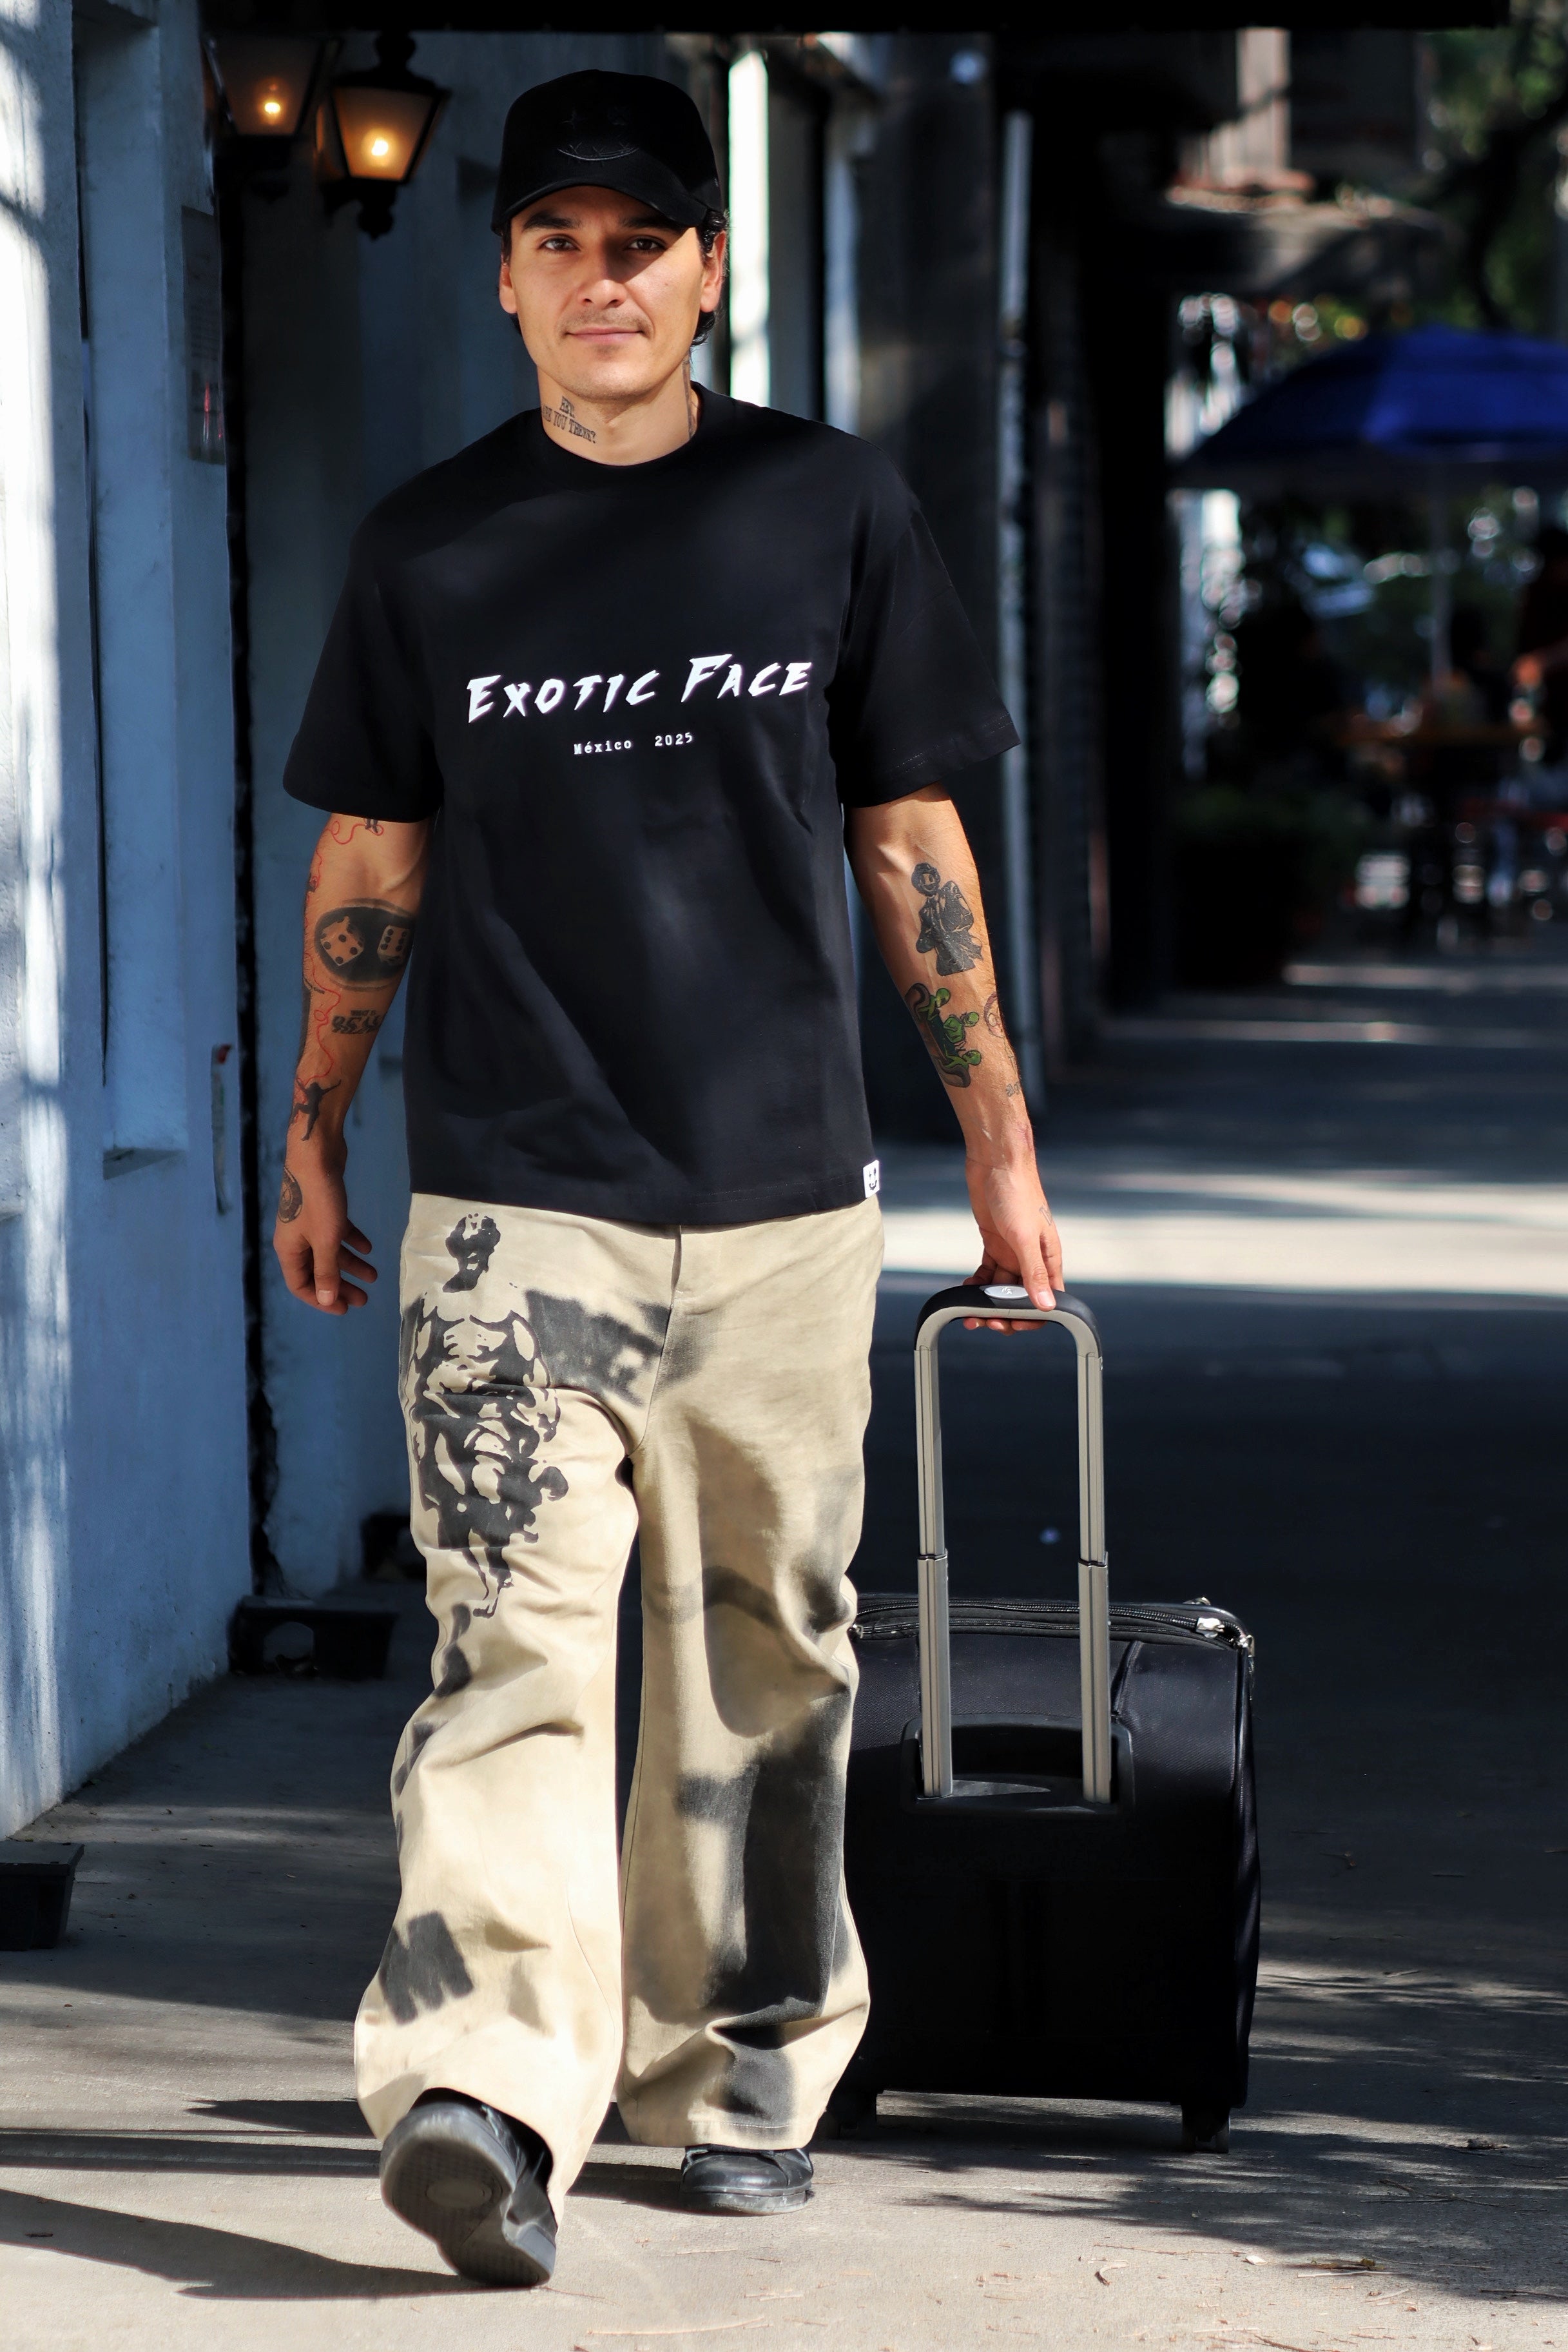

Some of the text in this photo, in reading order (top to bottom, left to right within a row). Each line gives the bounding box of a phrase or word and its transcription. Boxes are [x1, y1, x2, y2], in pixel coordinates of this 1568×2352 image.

[553, 410, 568, 431] YOU
[568, 418, 596, 444] THERE?
[466, 654, 813, 723] EXOTIC FACE
[574, 732, 693, 755] México 2025
